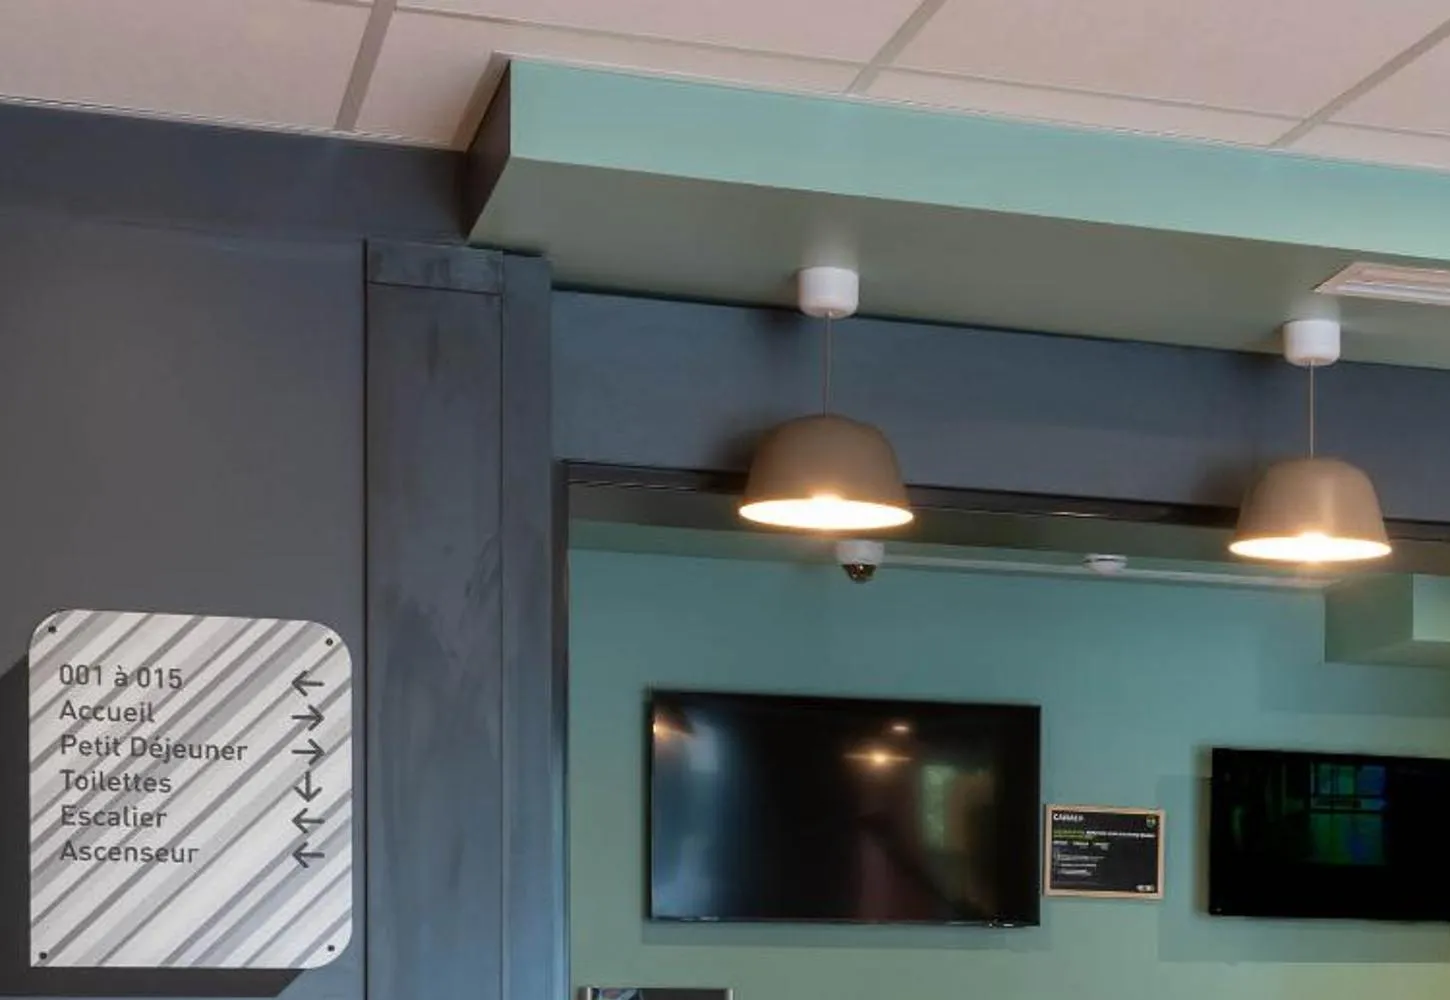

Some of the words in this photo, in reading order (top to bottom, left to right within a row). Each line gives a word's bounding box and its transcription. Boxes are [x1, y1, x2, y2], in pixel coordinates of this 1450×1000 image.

[59, 664, 102, 686] 001
[113, 665, 129, 687] à
[136, 667, 183, 689] 015
[59, 700, 155, 723] Accueil
[60, 734, 122, 757] Petit
[130, 736, 249, 764] Déjeuner
[59, 769, 173, 793] Toilettes
[60, 804, 169, 828] Escalier
[59, 839, 201, 863] Ascenseur
